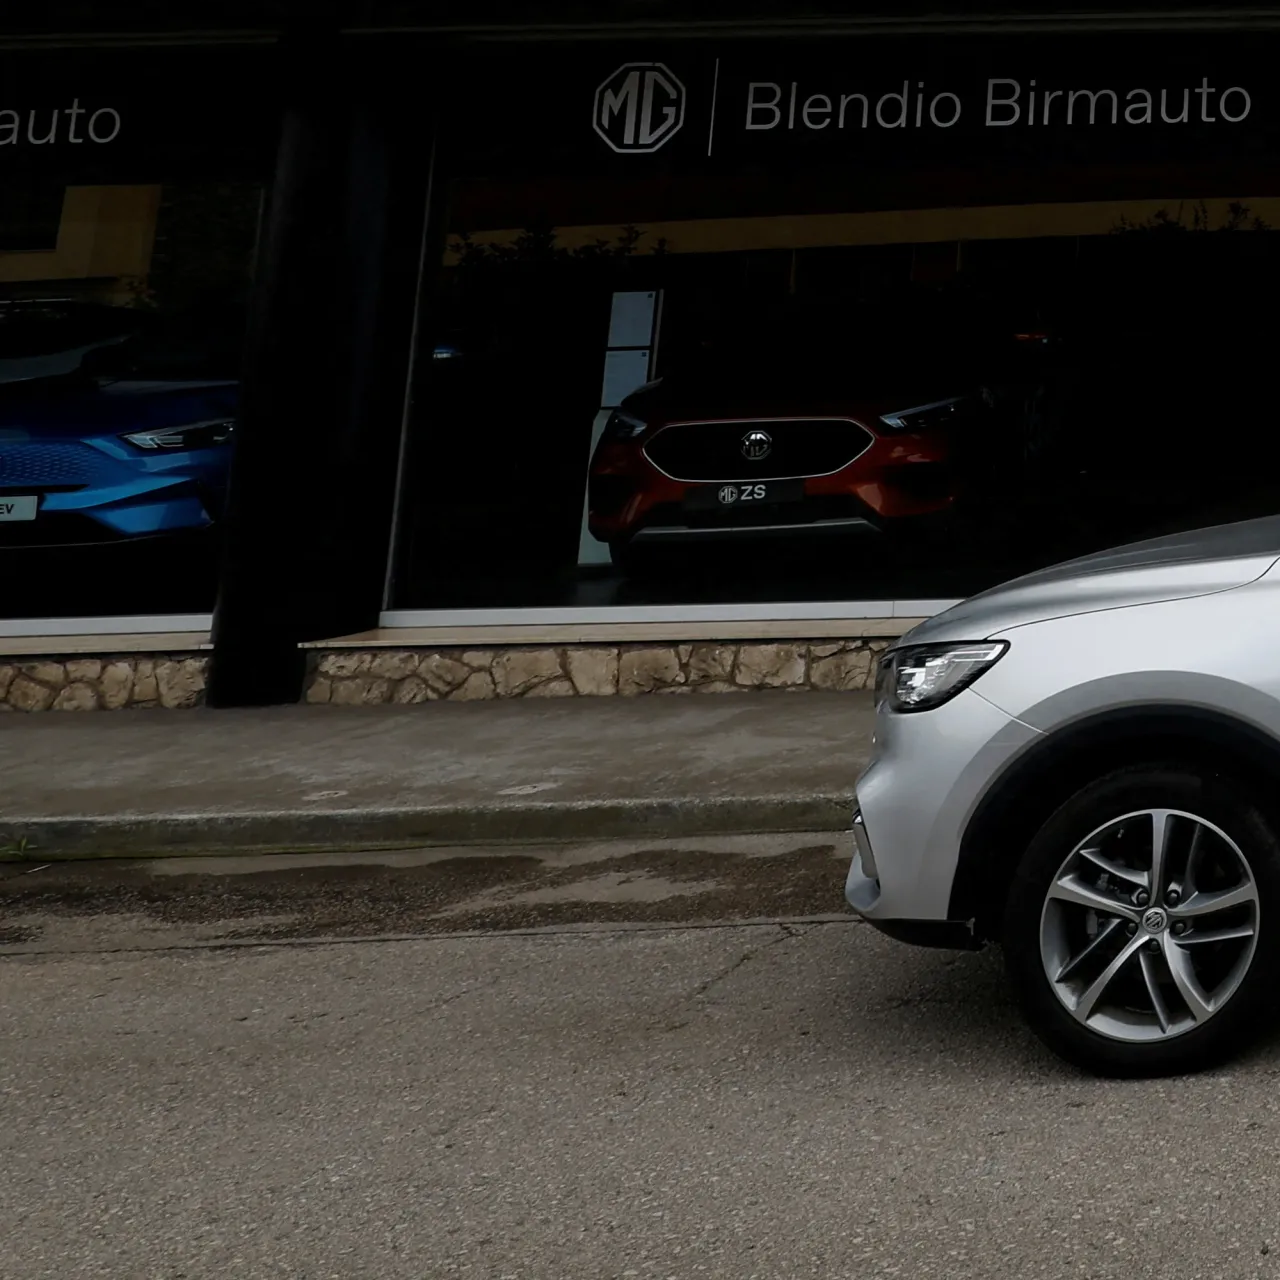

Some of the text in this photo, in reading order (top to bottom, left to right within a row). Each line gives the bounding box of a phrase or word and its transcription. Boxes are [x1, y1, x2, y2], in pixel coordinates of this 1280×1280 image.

[0, 97, 122, 146] auto
[601, 71, 1251, 144] MG Blendio Birmauto
[741, 485, 766, 500] ZS
